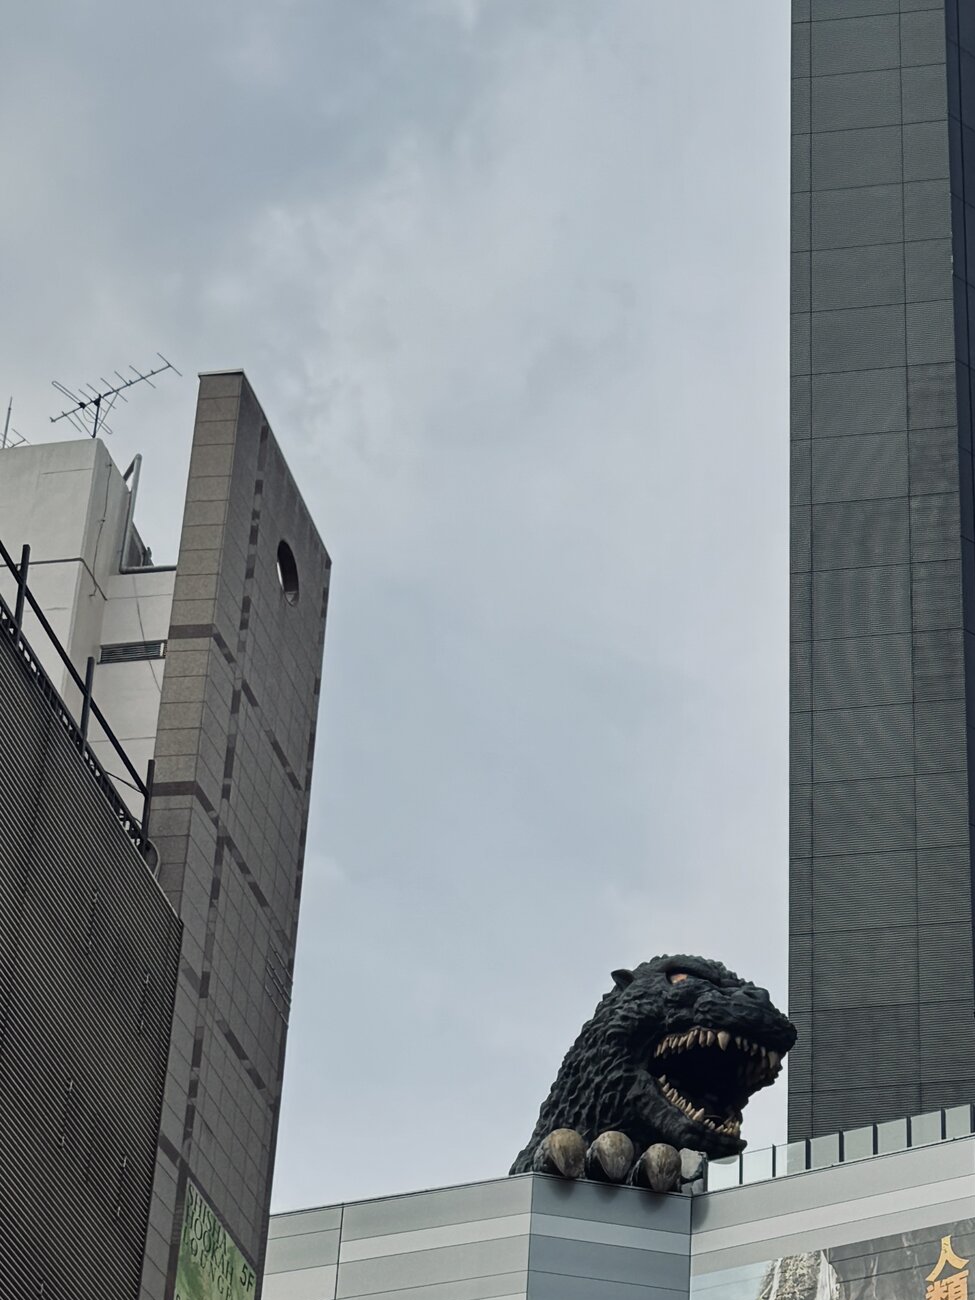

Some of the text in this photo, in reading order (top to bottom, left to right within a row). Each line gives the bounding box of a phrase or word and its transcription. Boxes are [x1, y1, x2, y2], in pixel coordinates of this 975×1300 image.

[185, 1205, 235, 1286] HOOKAH
[187, 1184, 228, 1257] SHISHA
[239, 1263, 254, 1292] 5F
